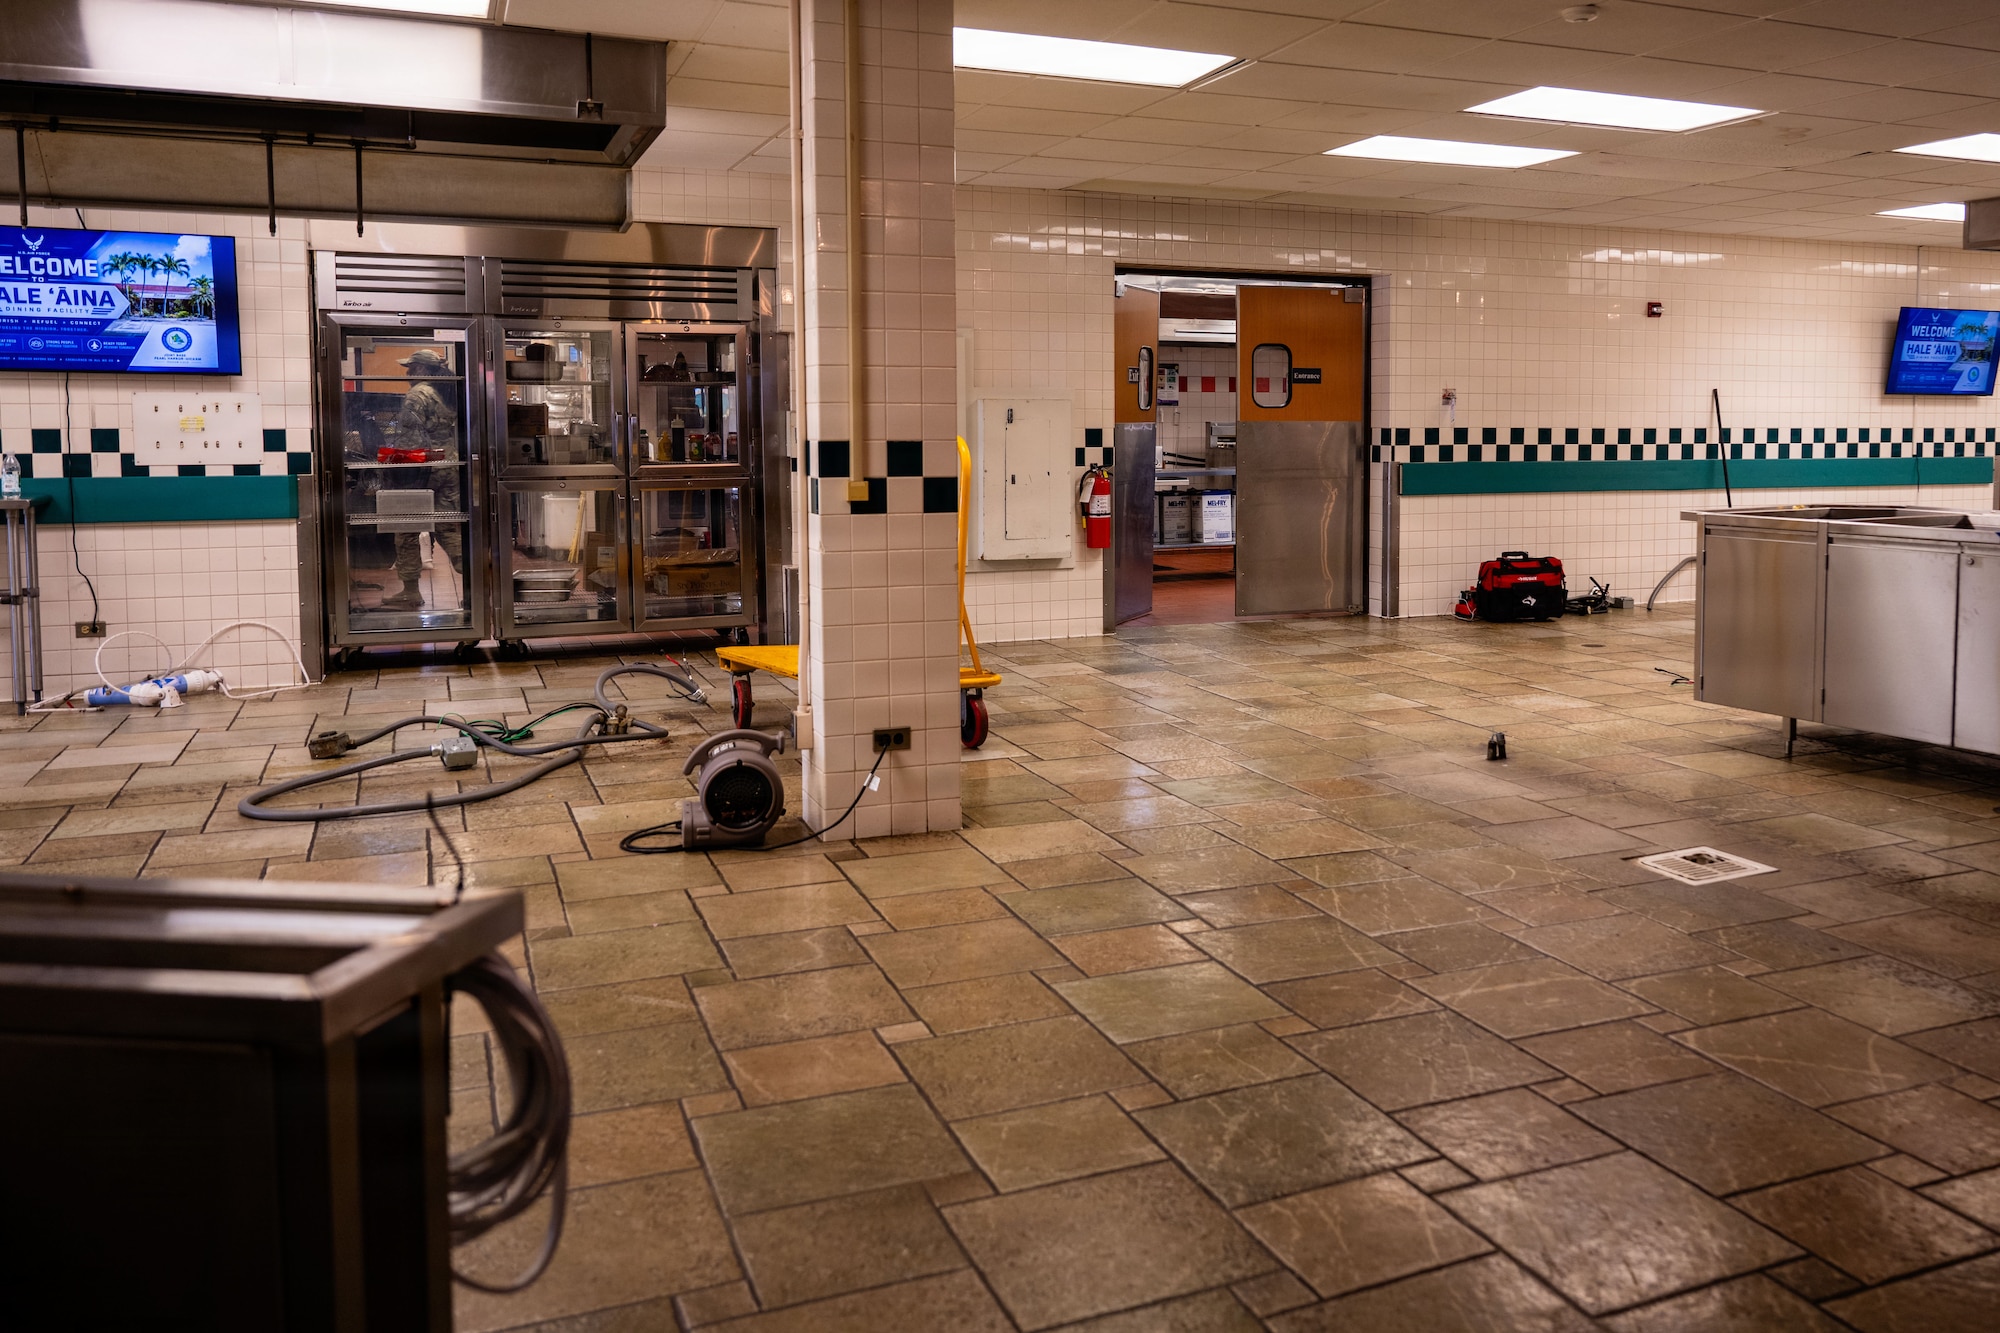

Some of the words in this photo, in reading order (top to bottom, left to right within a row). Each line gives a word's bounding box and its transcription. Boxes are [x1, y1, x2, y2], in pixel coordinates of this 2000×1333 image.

[0, 256, 98, 277] ELCOME
[0, 287, 42, 304] ALE
[1912, 326, 1956, 338] WELCOME
[1907, 344, 1932, 354] HALE
